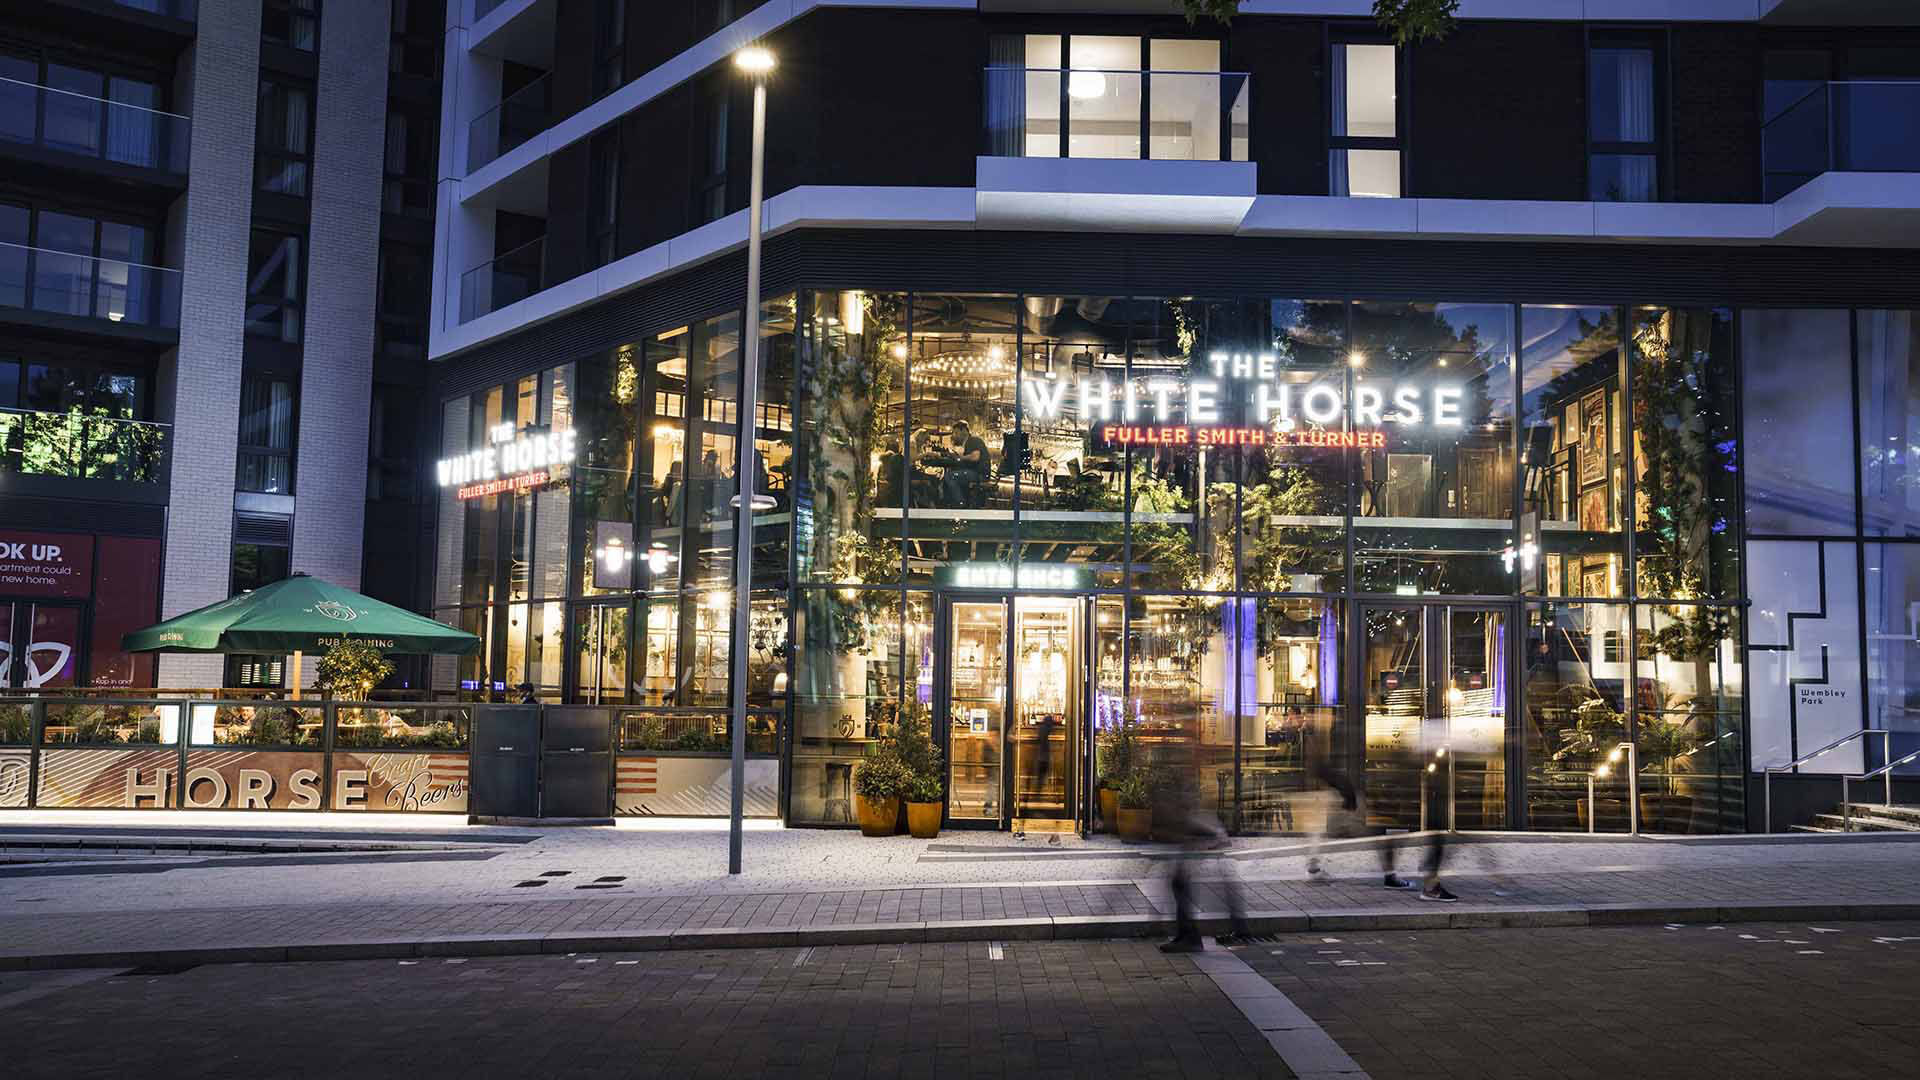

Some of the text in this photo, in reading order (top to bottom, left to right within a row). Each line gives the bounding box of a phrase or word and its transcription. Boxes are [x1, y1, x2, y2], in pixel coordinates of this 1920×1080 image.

[1210, 353, 1277, 378] THE
[1022, 382, 1464, 426] WHITE HORSE
[490, 421, 514, 443] THE
[1103, 427, 1385, 447] FULLER SMITH & TURNER
[437, 427, 576, 486] WHITE HORSE
[458, 483, 486, 499] FULLER
[486, 479, 507, 495] SMITH
[515, 472, 546, 489] TURNER
[32, 544, 63, 561] UP.
[2, 575, 57, 585] new home.
[43, 566, 72, 575] could
[318, 638, 340, 646] PUB
[1801, 689, 1846, 698] Wembley
[1801, 697, 1823, 705] Park
[126, 767, 369, 810] HORSE
[385, 771, 464, 811] Beers
